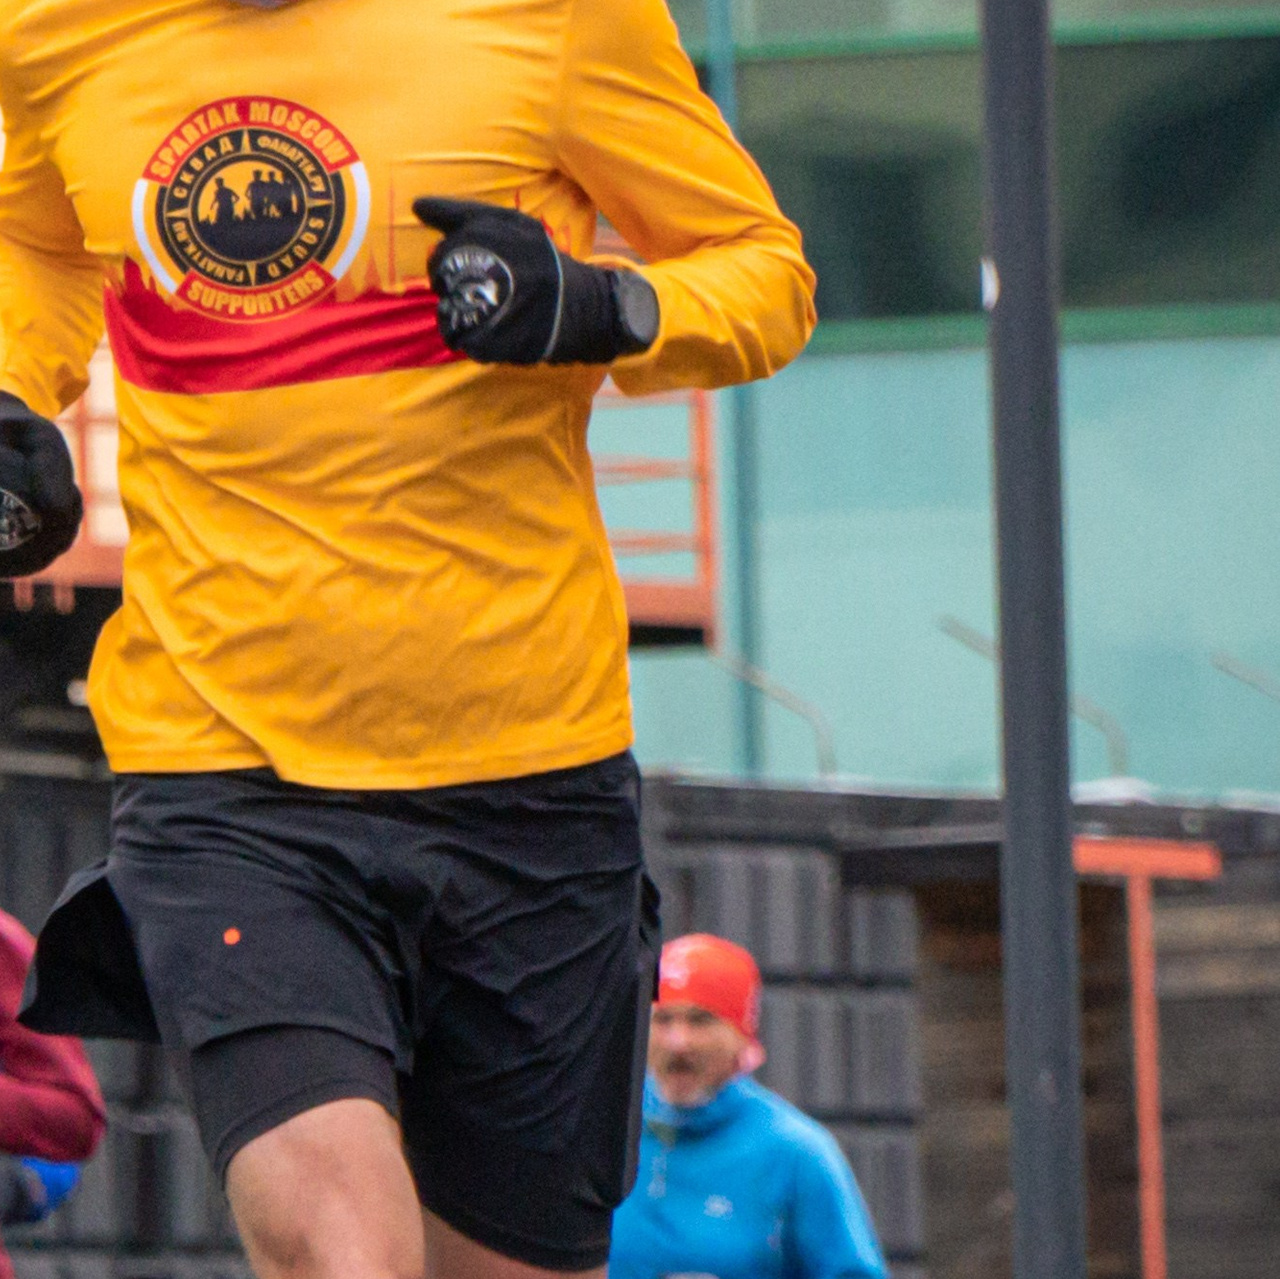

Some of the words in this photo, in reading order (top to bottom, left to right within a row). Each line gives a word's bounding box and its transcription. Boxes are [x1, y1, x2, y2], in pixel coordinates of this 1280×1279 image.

[150, 102, 241, 178] SPARTAK
[249, 101, 349, 164] MOSCOW
[267, 218, 325, 278] SQUAD
[187, 270, 325, 316] SUPPORTERS
